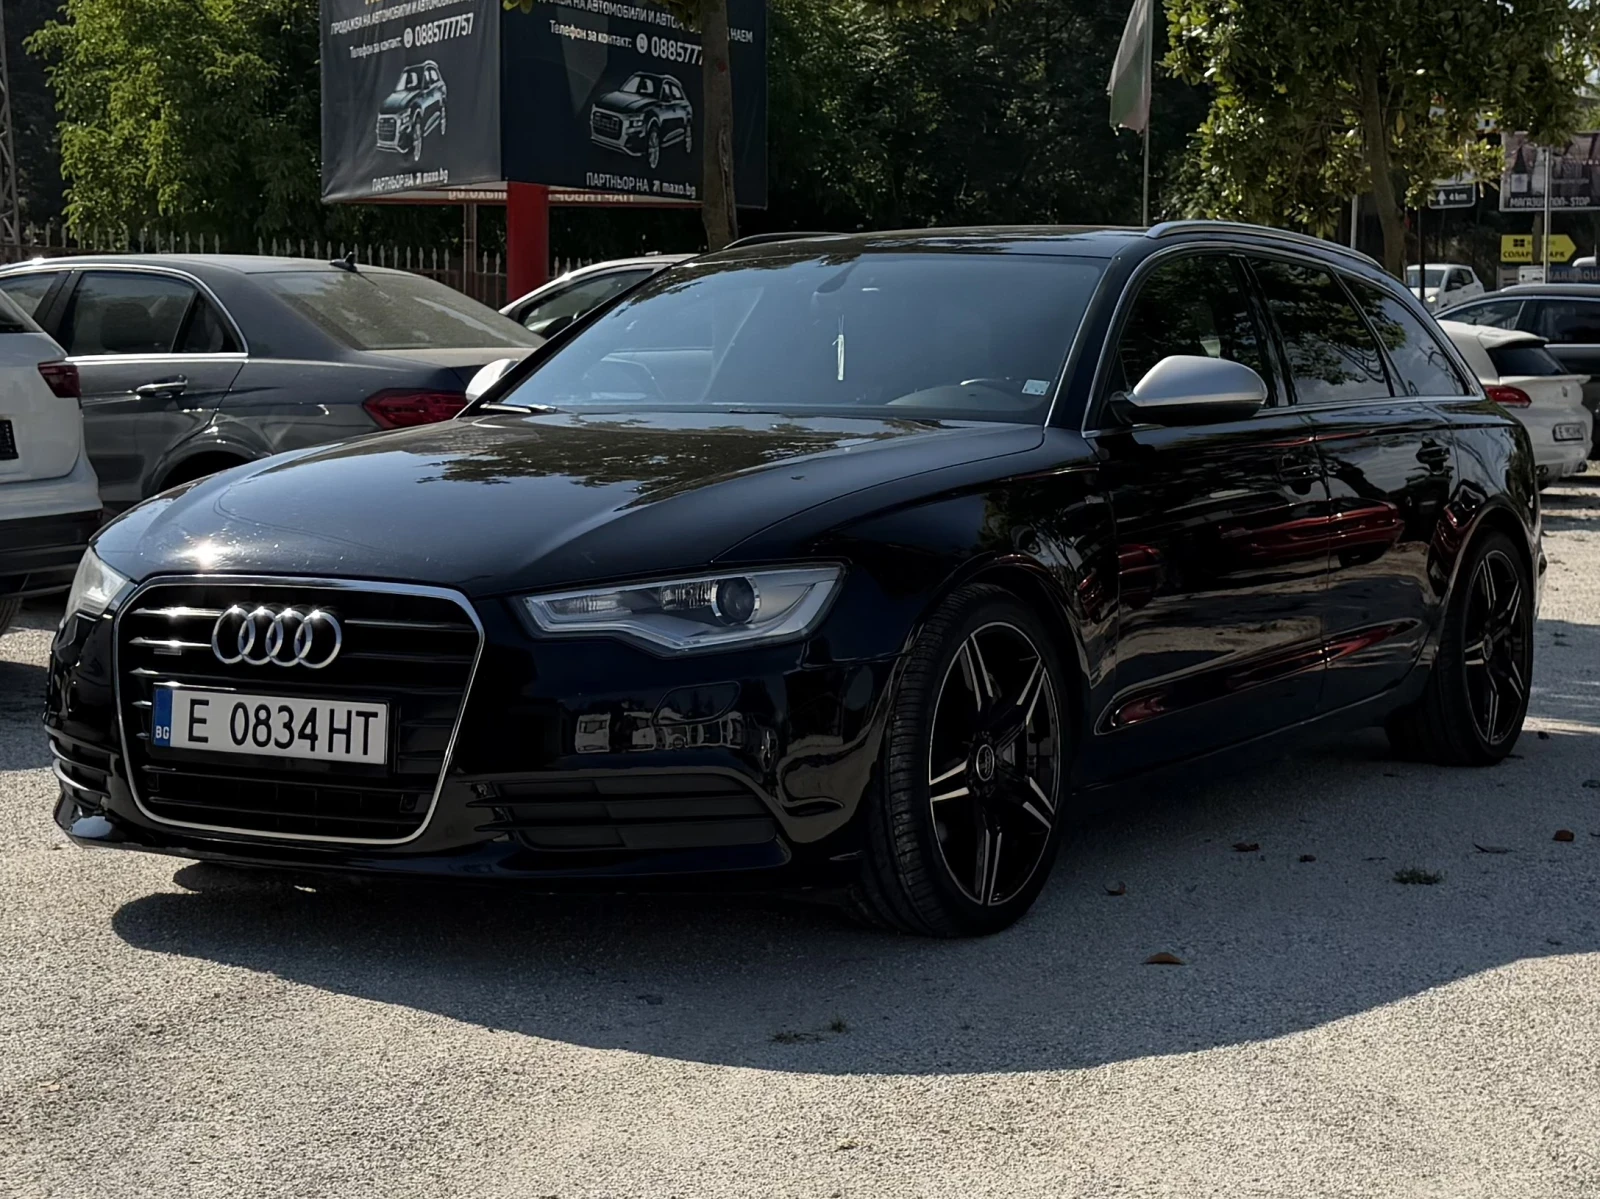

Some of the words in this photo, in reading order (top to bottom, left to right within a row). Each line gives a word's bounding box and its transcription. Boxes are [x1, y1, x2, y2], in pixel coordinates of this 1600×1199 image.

[415, 13, 474, 46] 0885777757
[549, 20, 587, 40] Телефон
[587, 31, 597, 42] за
[586, 0, 647, 22] АВТОМОБИЛИ
[647, 10, 654, 23] И
[730, 27, 753, 43] НАЕМ
[586, 172, 635, 190] ПАРТНЬОР
[636, 178, 649, 192] НА
[1449, 192, 1454, 201] 4
[188, 698, 210, 744] E
[155, 725, 170, 740] BG
